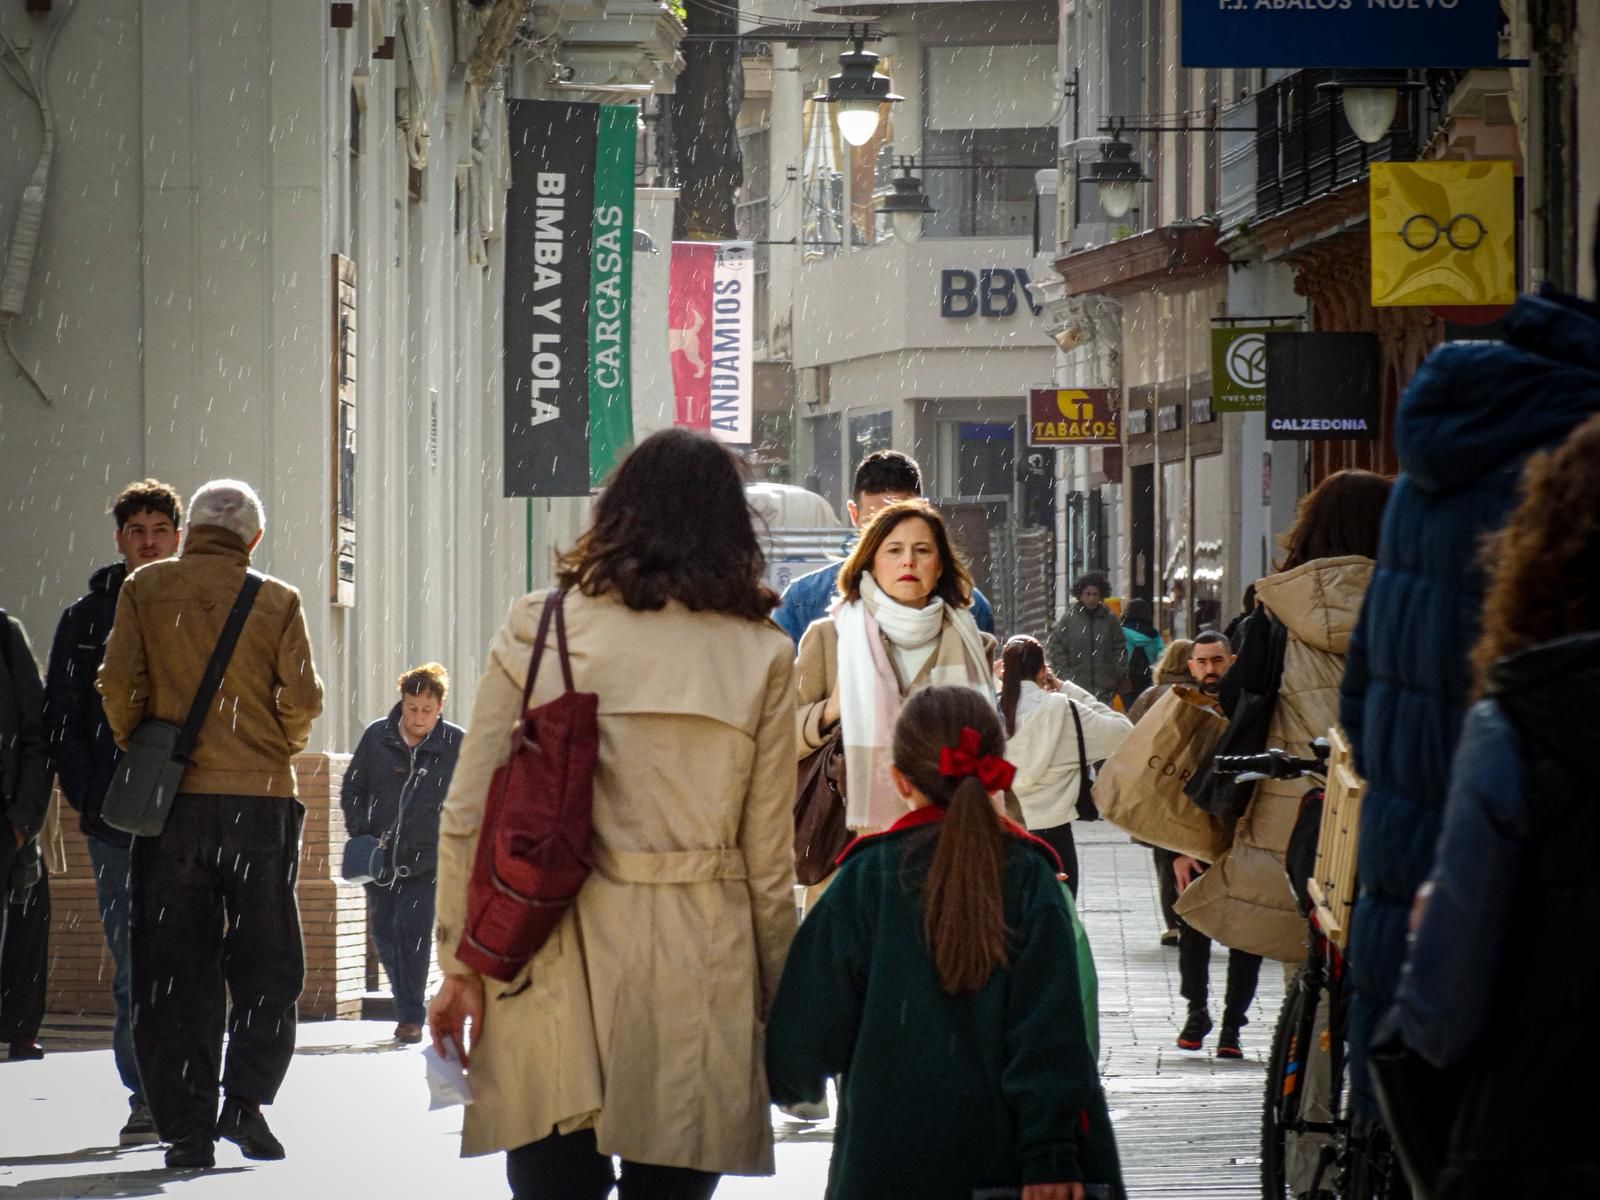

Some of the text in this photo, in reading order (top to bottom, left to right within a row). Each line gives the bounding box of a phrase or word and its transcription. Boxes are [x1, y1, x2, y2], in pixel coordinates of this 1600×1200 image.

[531, 172, 566, 426] BIMBA Y LOLA
[595, 206, 623, 389] CARCASAS
[711, 279, 742, 432] ANDAMIOS
[1035, 422, 1117, 437] TABACOS
[1271, 418, 1368, 431] CALZEDONIA
